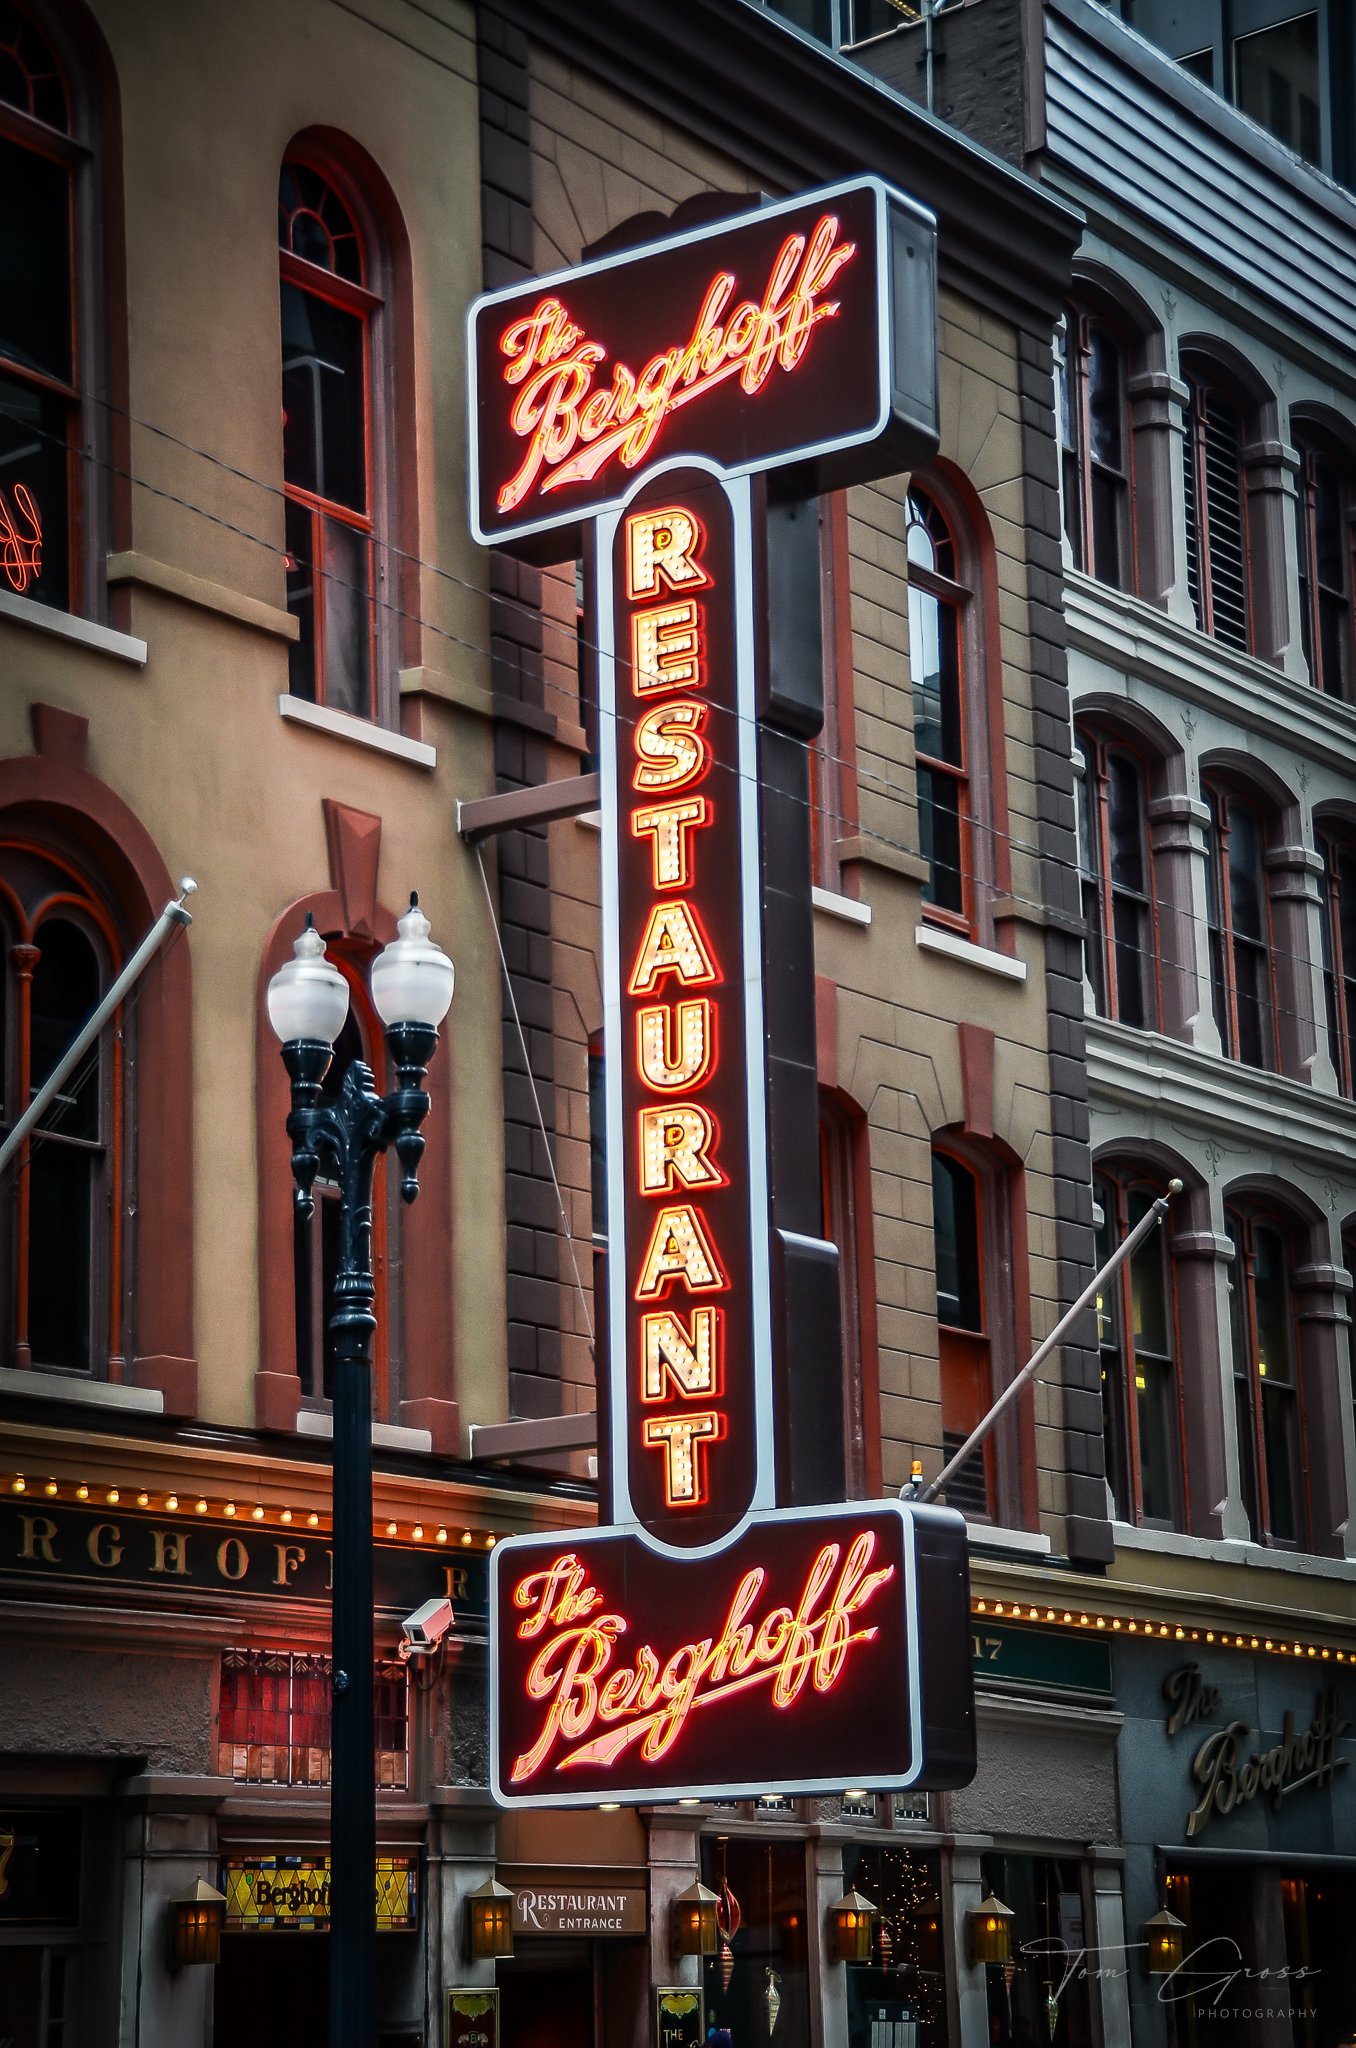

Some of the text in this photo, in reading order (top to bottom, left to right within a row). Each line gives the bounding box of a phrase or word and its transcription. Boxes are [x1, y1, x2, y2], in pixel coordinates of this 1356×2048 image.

[497, 214, 857, 514] Berghoff
[502, 298, 586, 384] The
[625, 506, 726, 1508] RESTAURANT
[16, 1514, 334, 1590] RGHOF
[512, 1553, 605, 1638] The
[510, 1530, 895, 1782] Berghoff
[1164, 1662, 1220, 1735] The
[1186, 1684, 1354, 1836] Berghoff
[256, 1879, 331, 1912] Berghof
[558, 1917, 623, 1930] ENTRANCE
